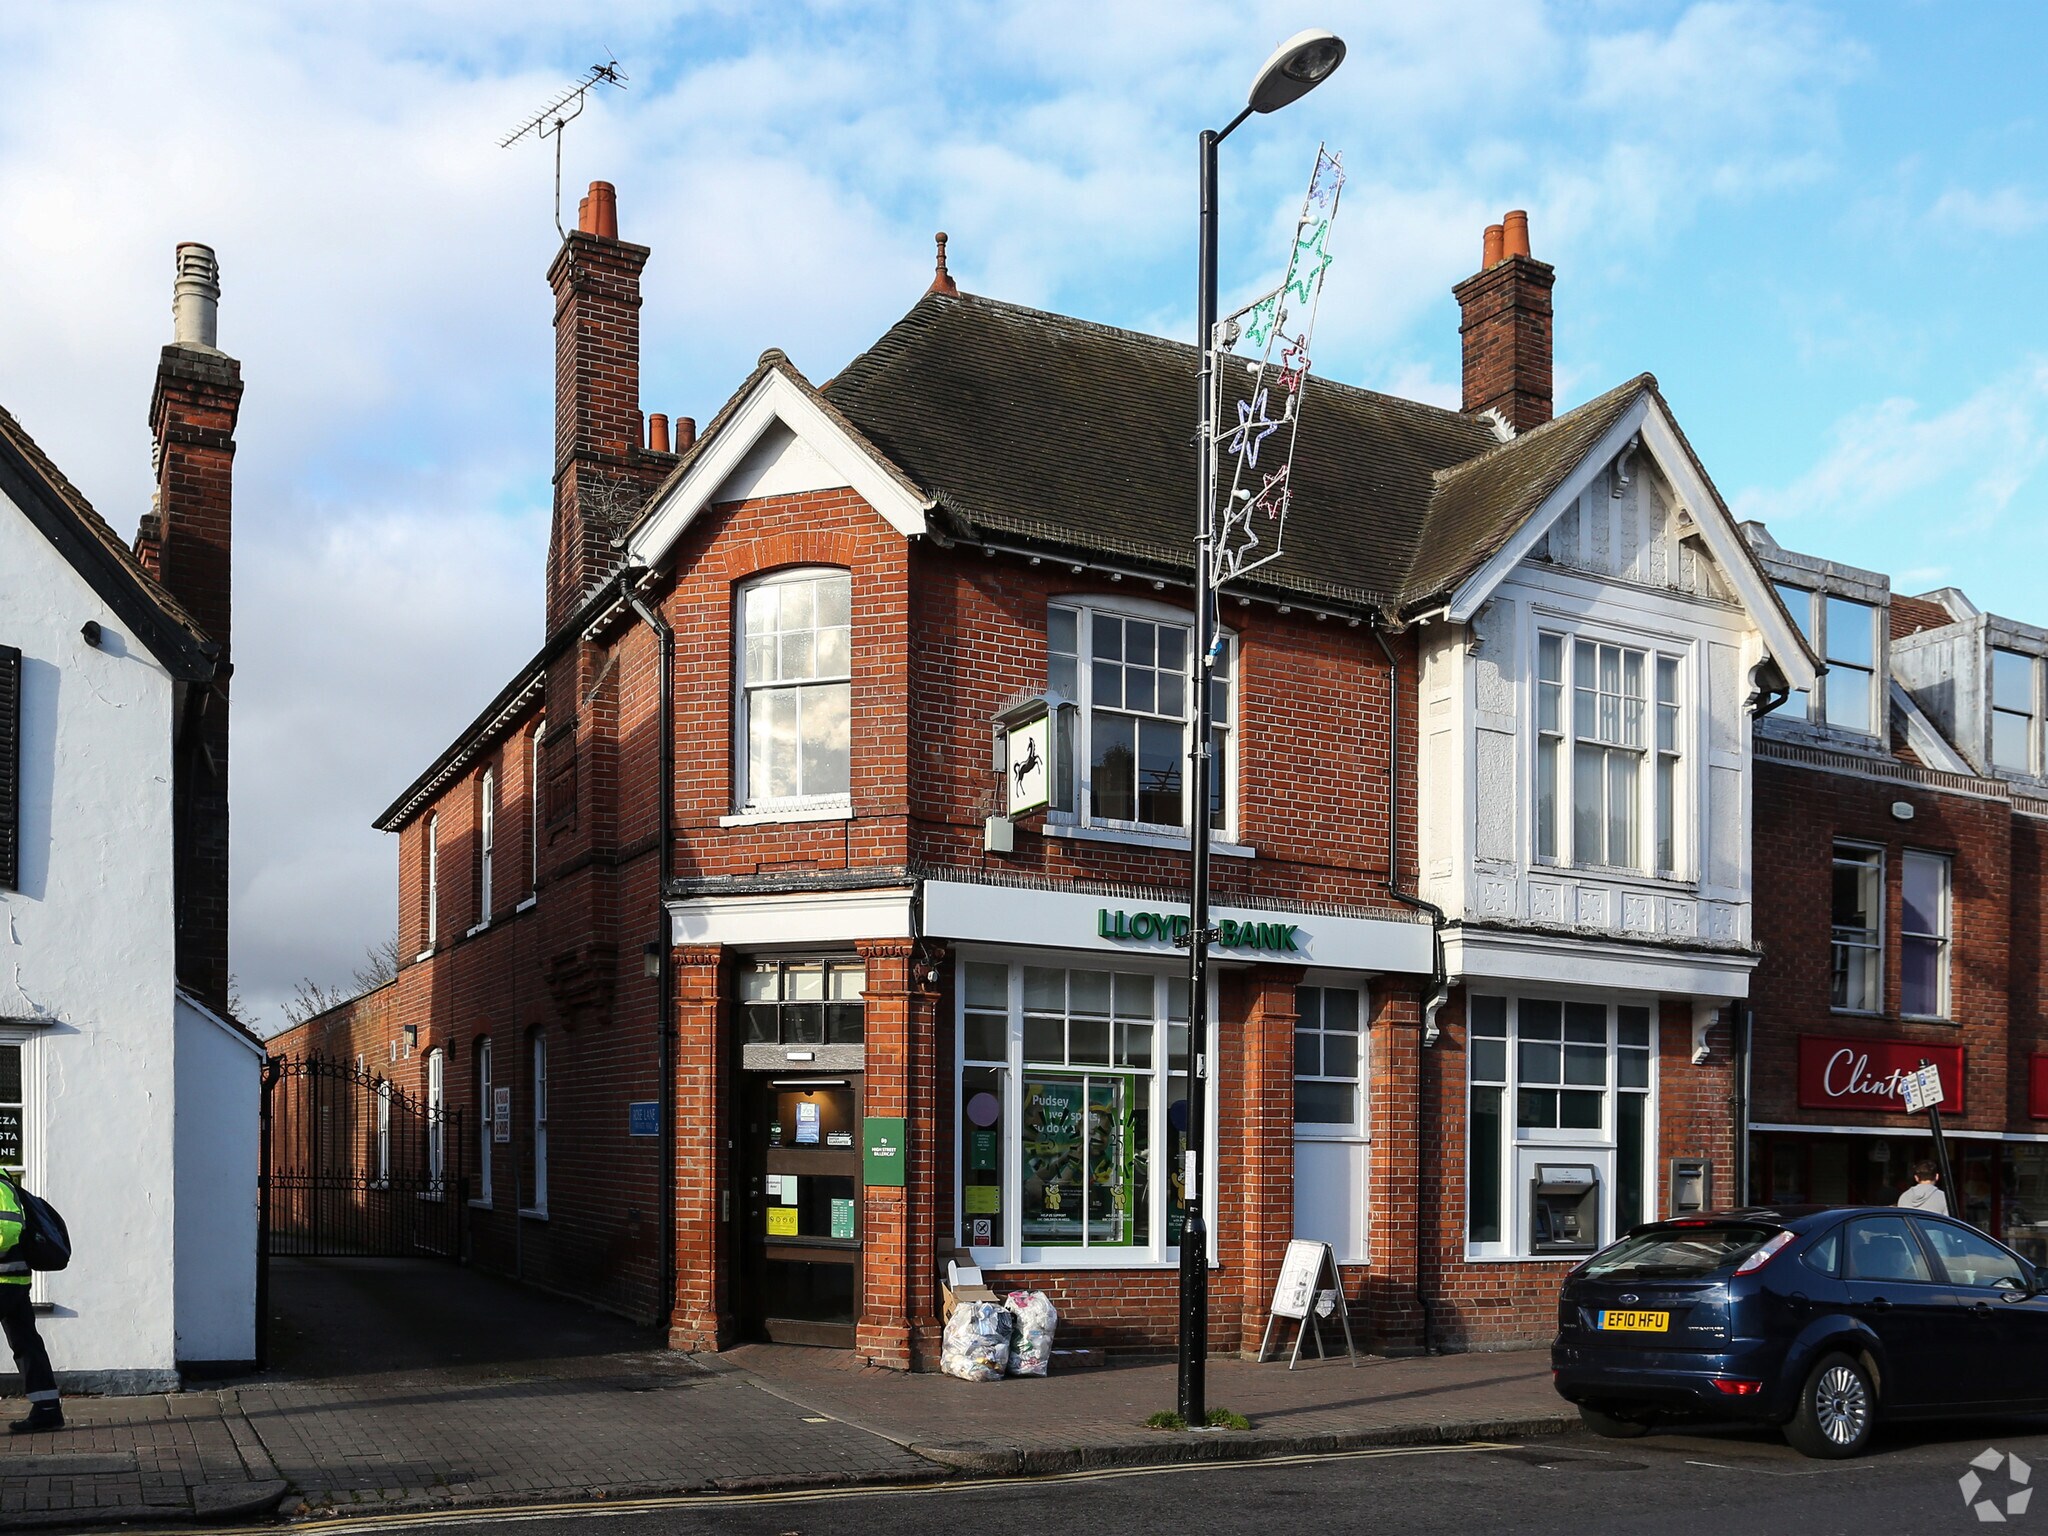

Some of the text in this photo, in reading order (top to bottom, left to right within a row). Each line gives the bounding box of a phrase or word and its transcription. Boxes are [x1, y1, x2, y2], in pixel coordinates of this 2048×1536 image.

[1098, 908, 1299, 950] LLOYD BANK
[1824, 1048, 1912, 1099] Clint
[1032, 1094, 1069, 1109] Pudsey
[0, 1116, 18, 1125] ZA
[1070, 1111, 1100, 1124] spts,
[1047, 1123, 1060, 1133] do
[1608, 1312, 1665, 1328] EF10 HFU
